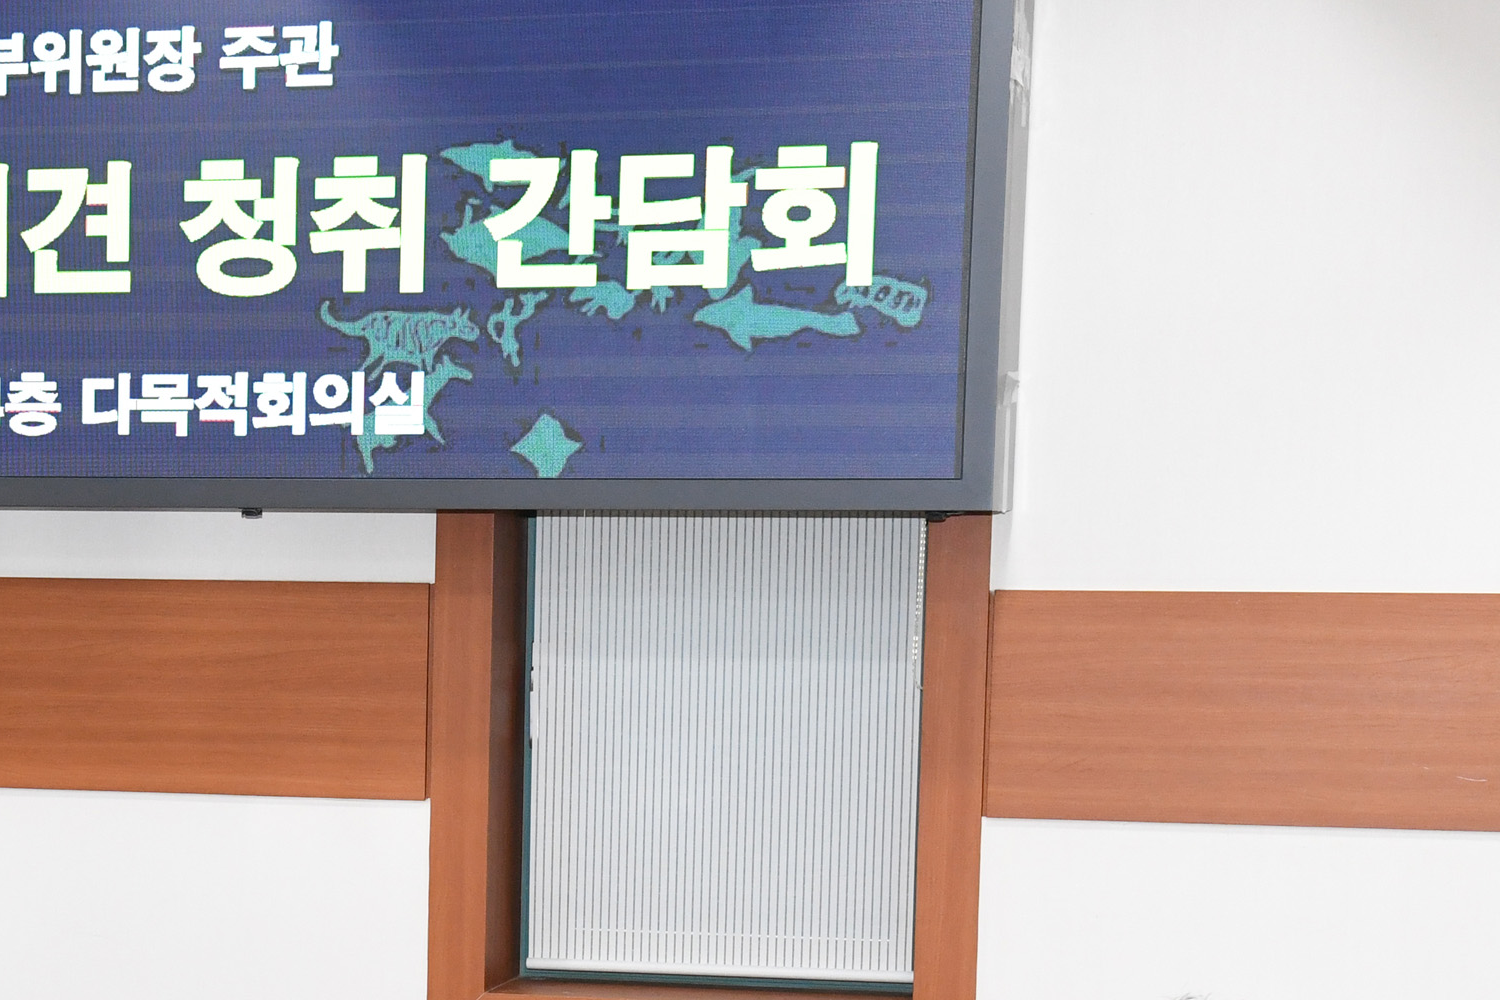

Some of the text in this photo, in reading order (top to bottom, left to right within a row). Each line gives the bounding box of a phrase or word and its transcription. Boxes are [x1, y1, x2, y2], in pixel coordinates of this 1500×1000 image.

[219, 20, 340, 90] 주관
[179, 153, 428, 297] 청취
[482, 141, 880, 291] 간담회
[80, 371, 426, 437] 다목적회의실
